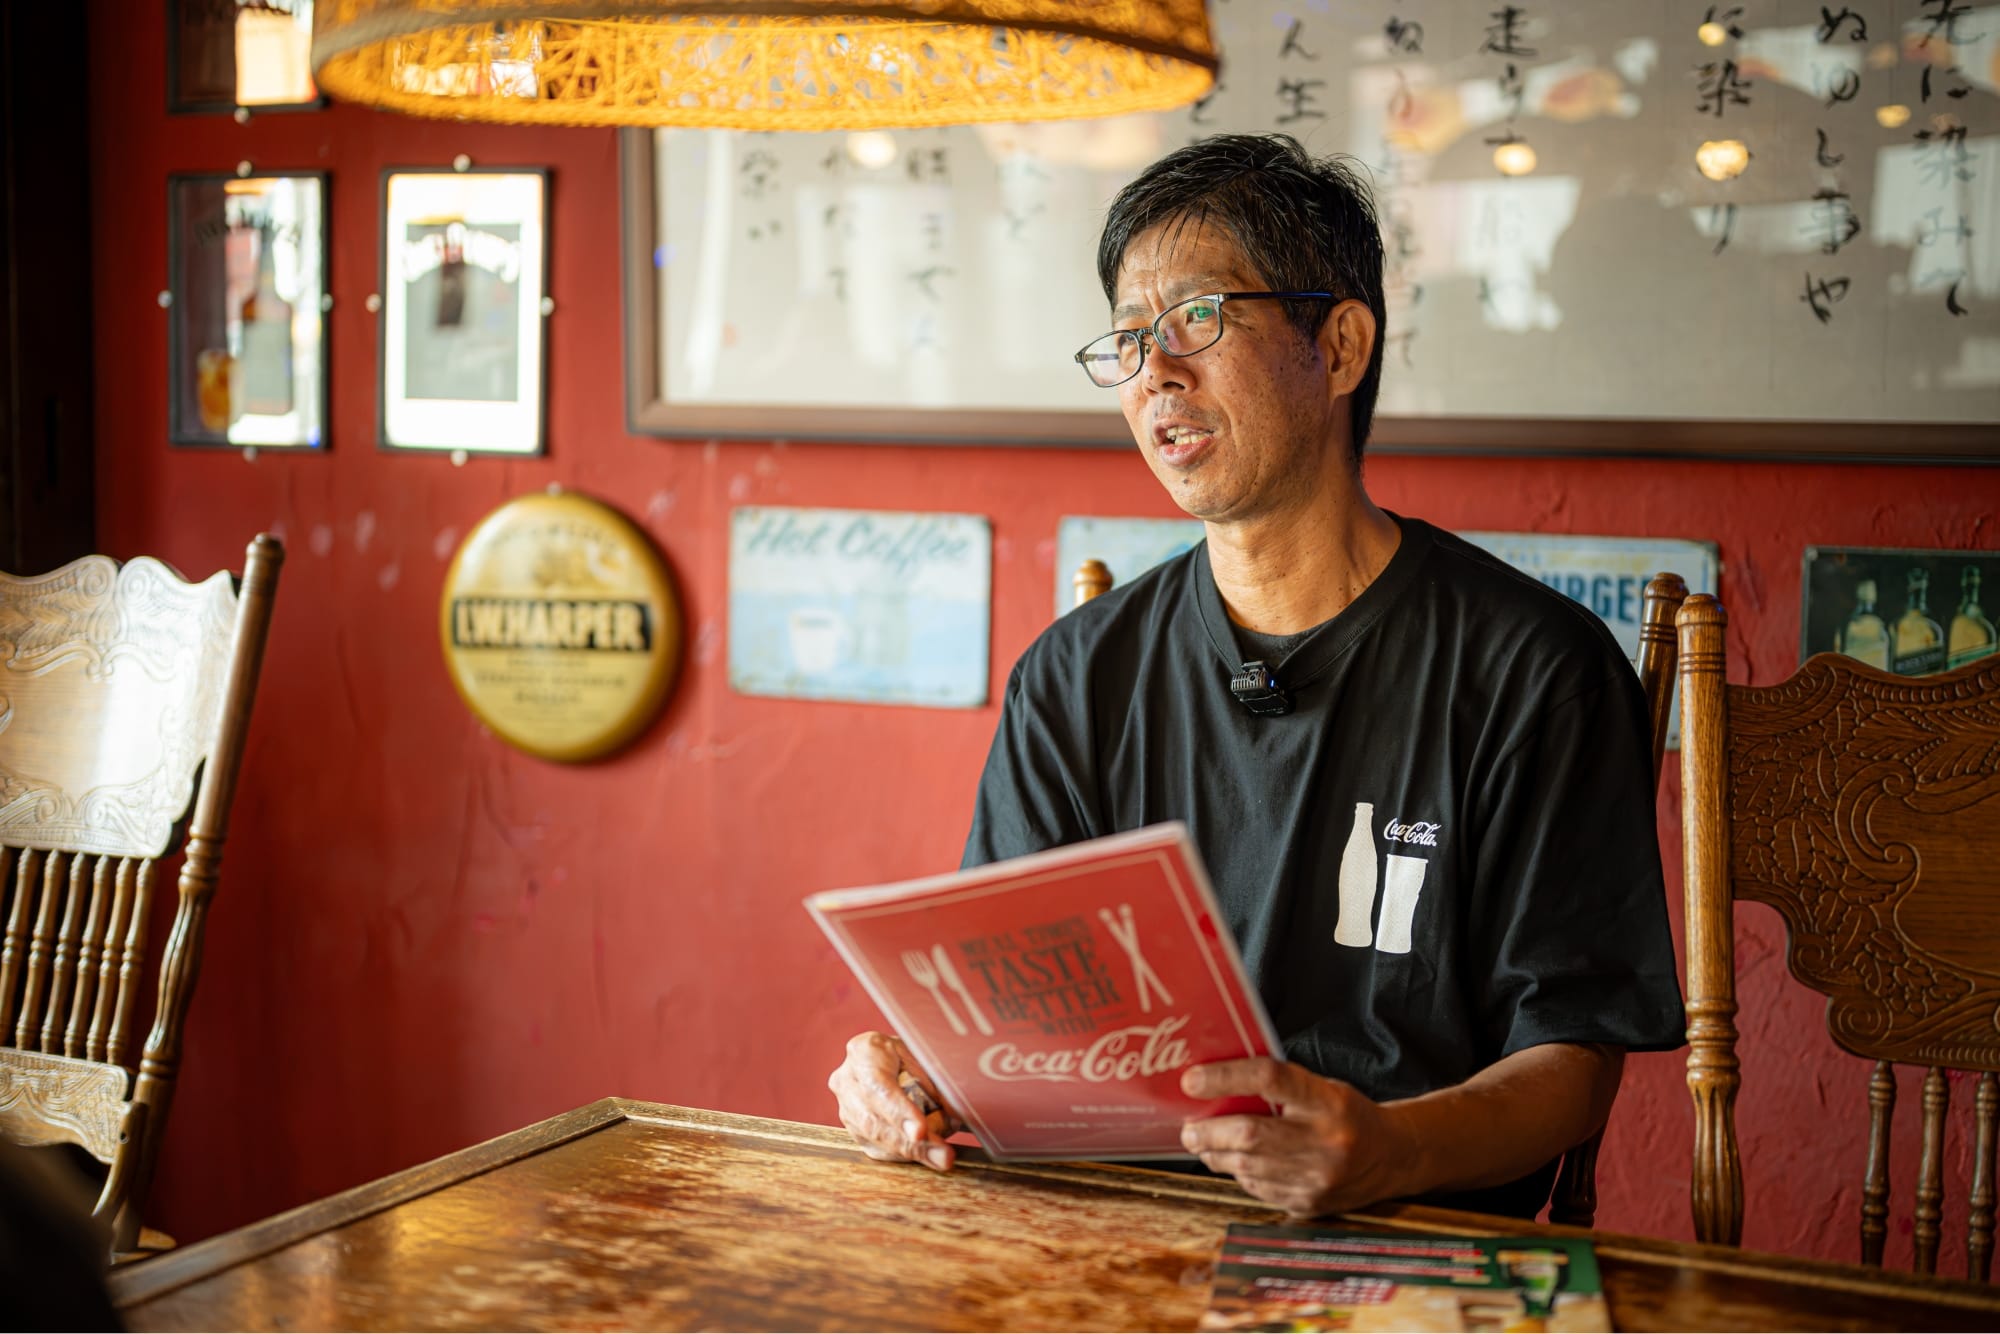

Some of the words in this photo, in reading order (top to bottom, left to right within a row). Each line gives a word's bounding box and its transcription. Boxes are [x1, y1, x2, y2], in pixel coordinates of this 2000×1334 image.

[1384, 817, 1442, 846] Coca-Cola
[968, 937, 1106, 996] TASTE
[990, 975, 1121, 1022] BETTER
[977, 1014, 1191, 1082] Coca-Cola
